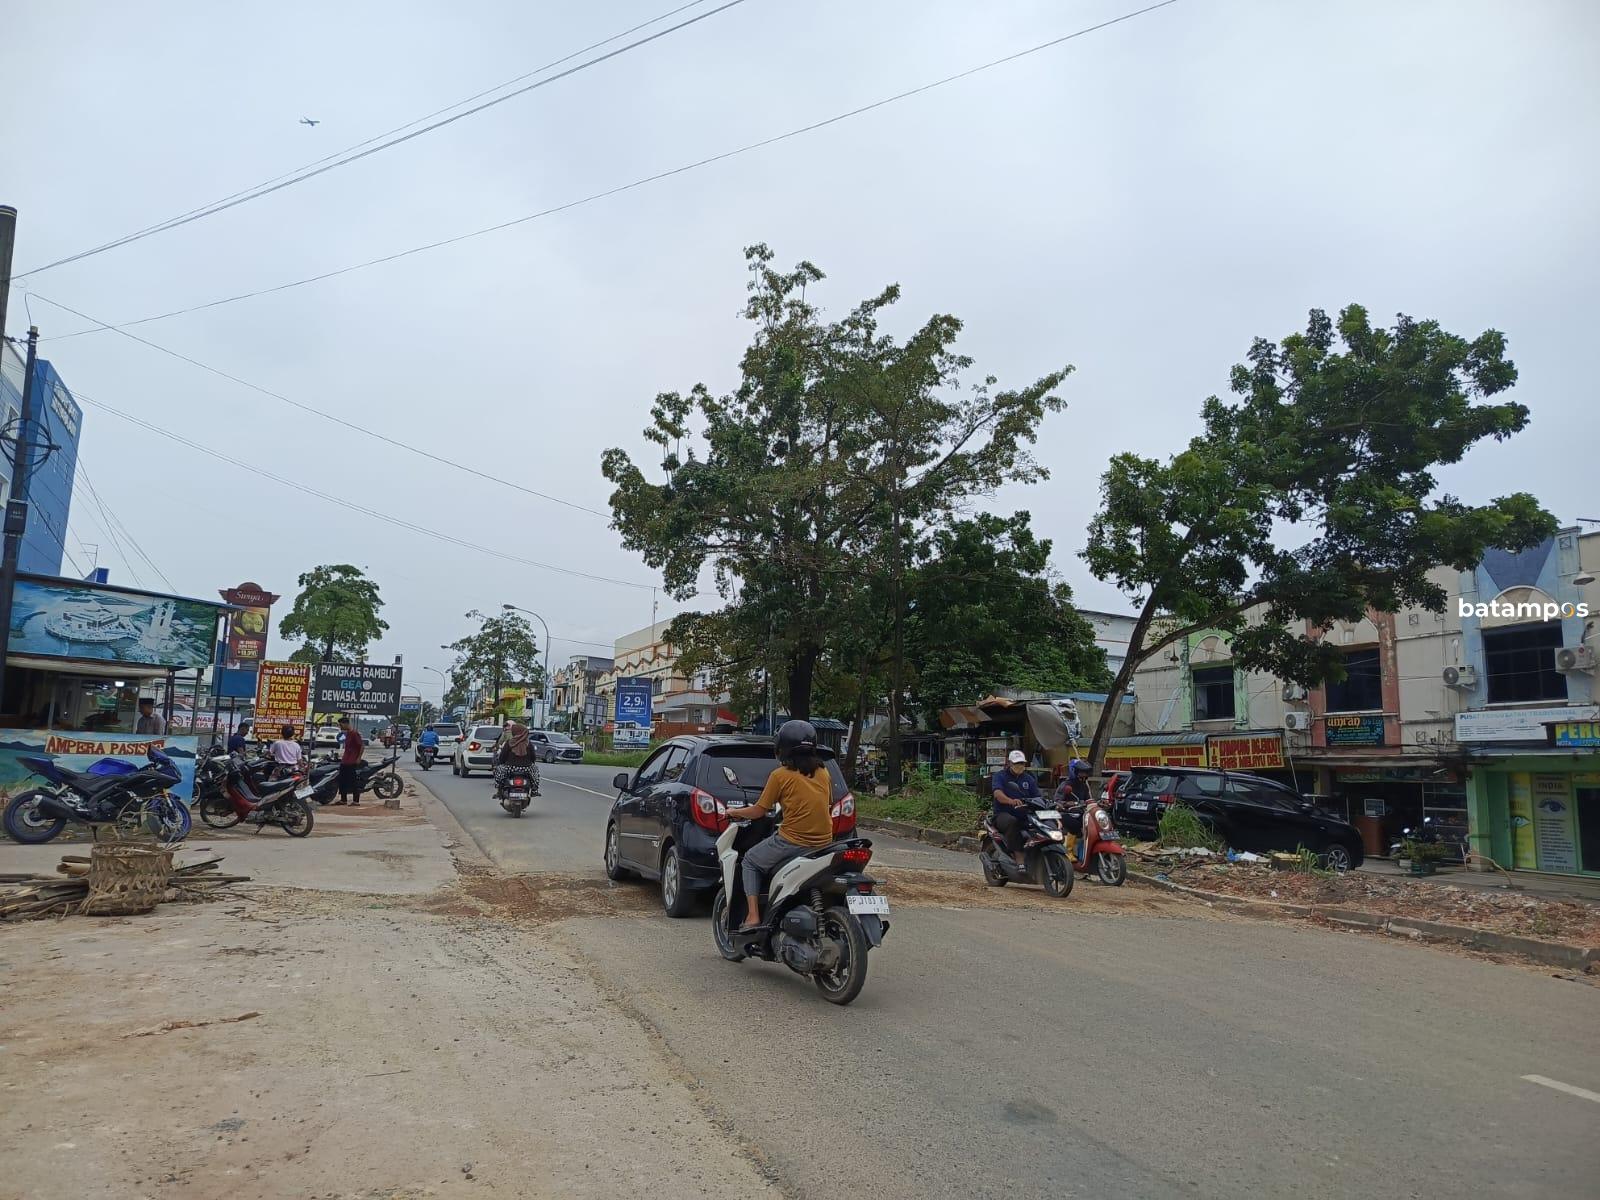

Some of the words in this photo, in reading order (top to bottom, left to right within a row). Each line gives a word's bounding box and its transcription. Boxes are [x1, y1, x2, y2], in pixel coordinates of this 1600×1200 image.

[320, 664, 361, 678] PANGKAS
[363, 667, 397, 679] RAMBUT
[359, 691, 387, 703] 20.000
[388, 693, 395, 703] K
[46, 736, 105, 755] AMPERA
[110, 739, 164, 756] PASIS
